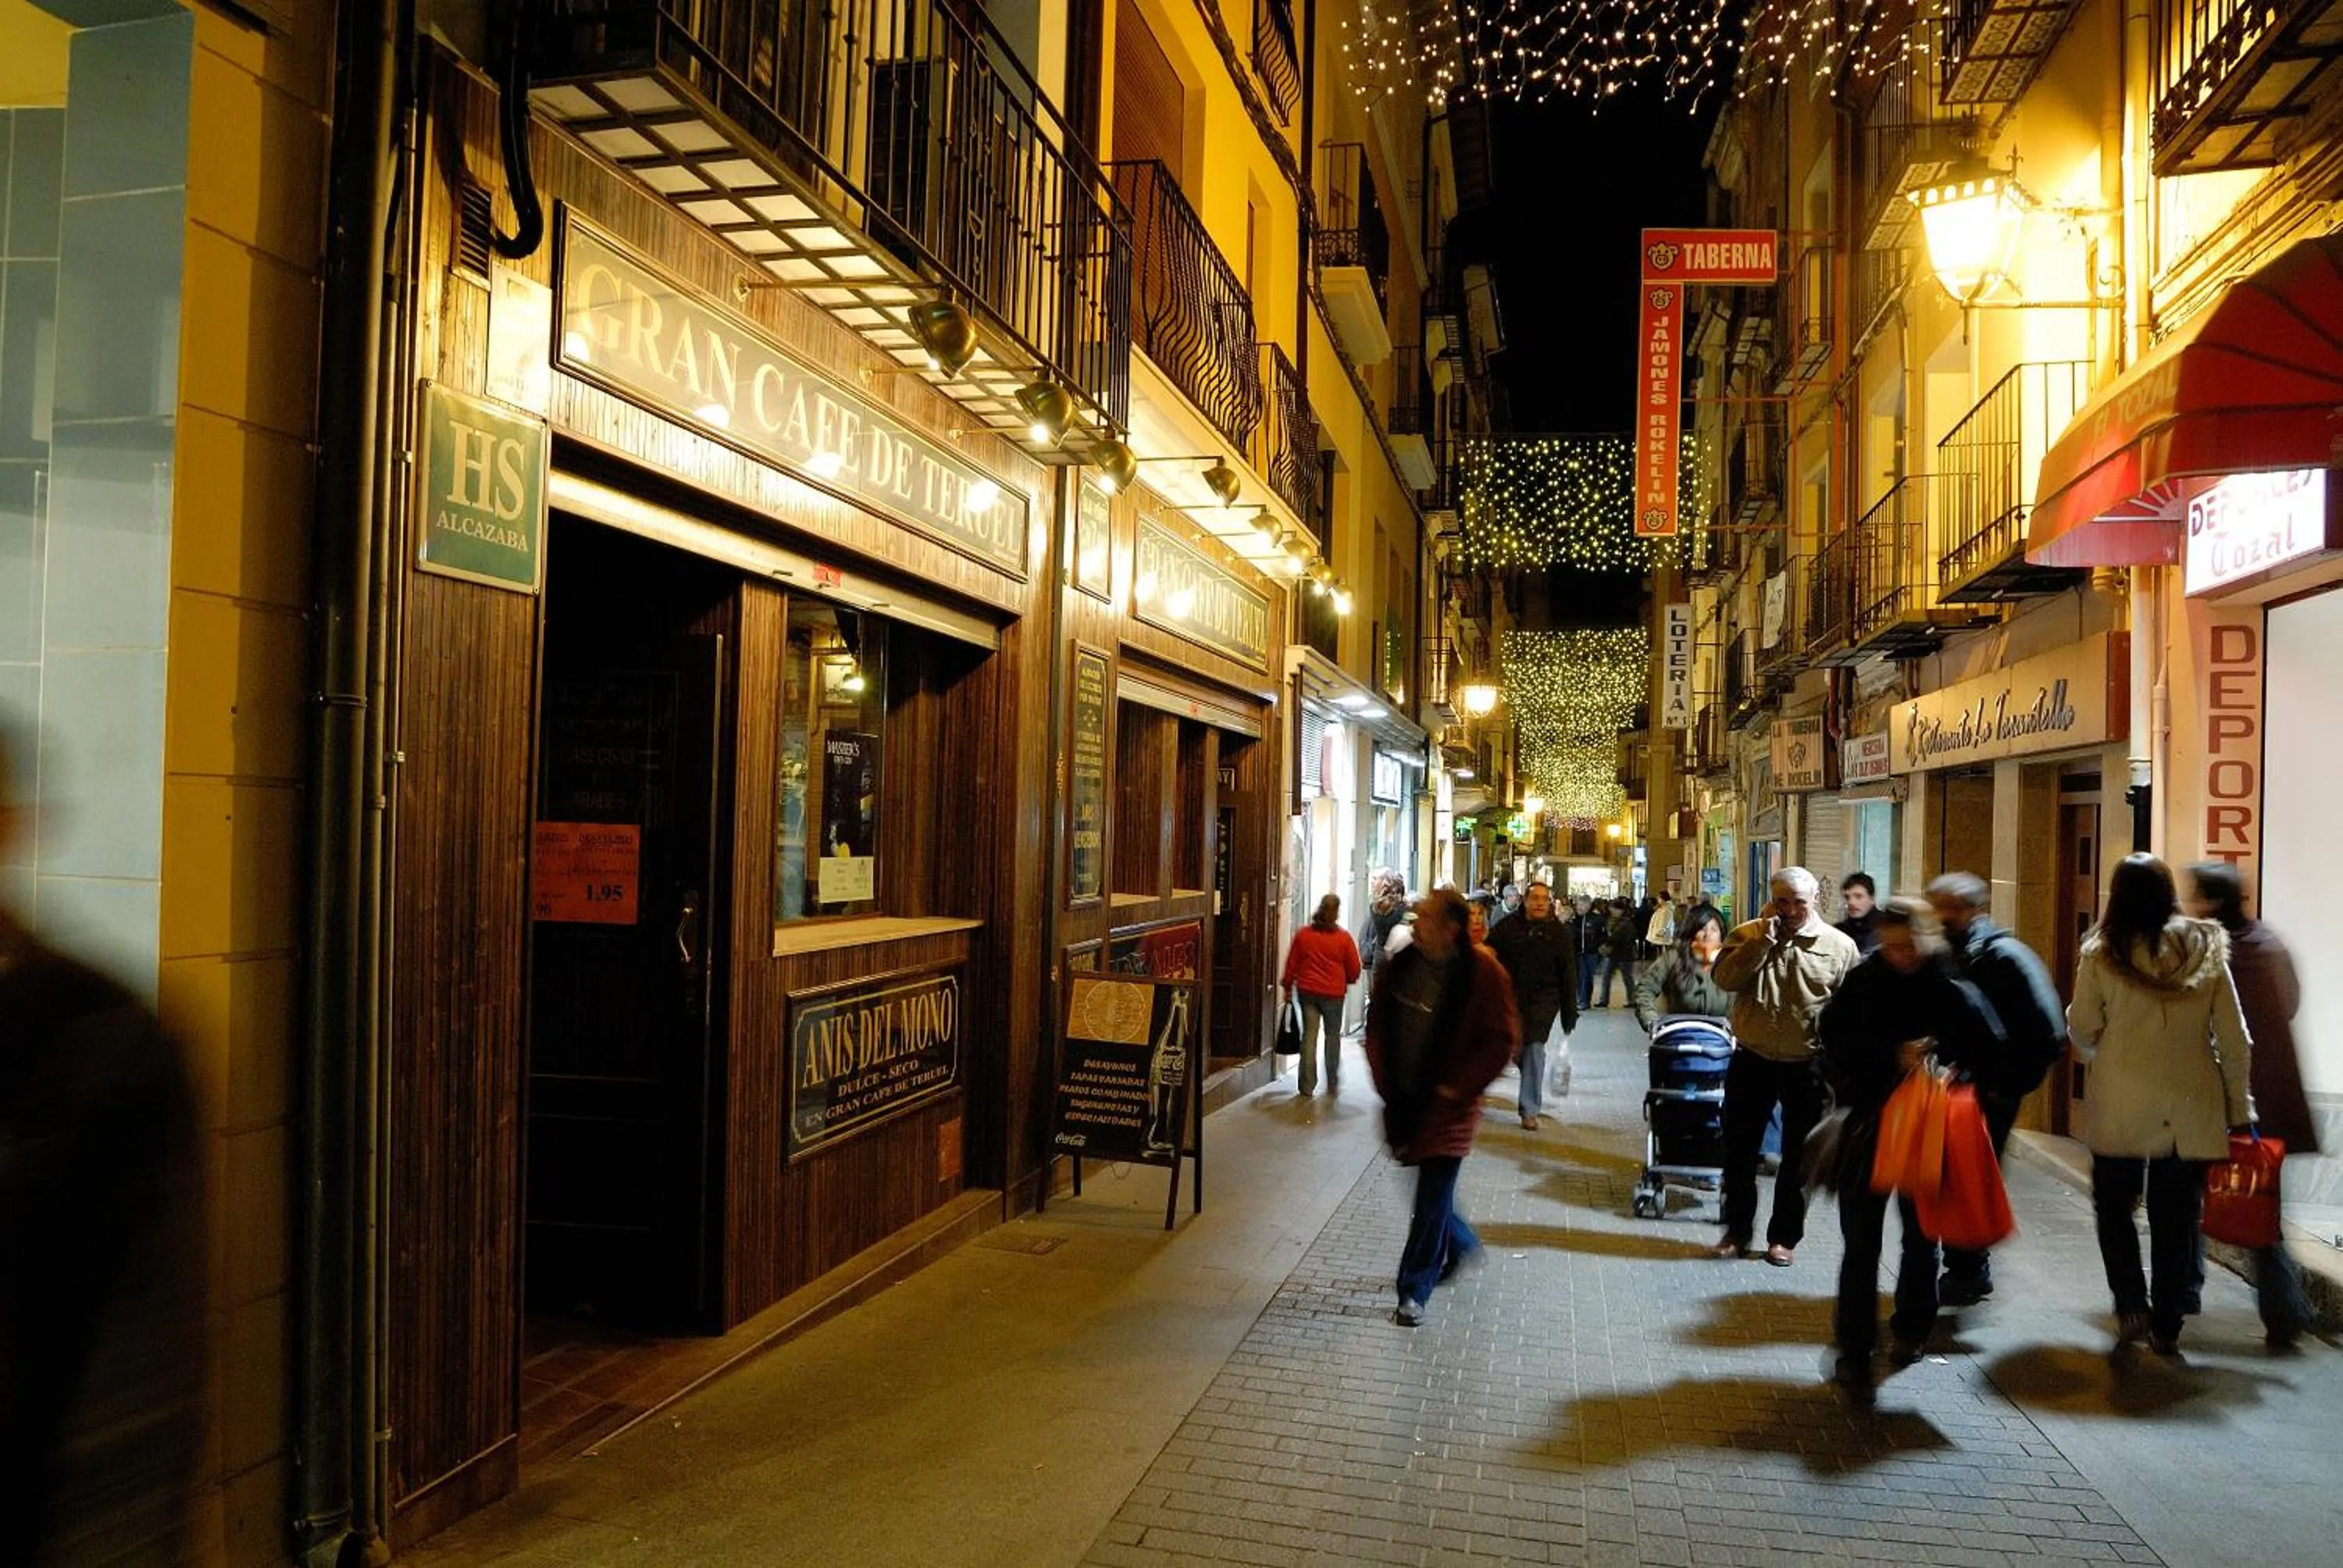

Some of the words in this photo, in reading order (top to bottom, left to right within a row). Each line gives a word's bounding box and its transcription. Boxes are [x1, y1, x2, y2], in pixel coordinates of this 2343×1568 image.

[1683, 243, 1773, 269] TABERNA
[1650, 315, 1671, 405] JAMONES
[576, 263, 742, 414] GRAN
[754, 362, 862, 474] CAFE
[870, 423, 914, 501] DE
[919, 454, 1022, 555] TERUEL
[446, 419, 526, 521] HS
[1648, 414, 1669, 504] ROKELIN
[436, 510, 529, 552] ALCAZABA
[1670, 609, 1688, 711] LOTERIA
[2206, 624, 2256, 900] DEPORT
[802, 1013, 854, 1089] ANIS
[858, 1002, 897, 1069] DEL
[899, 988, 953, 1057] MONO
[837, 1071, 880, 1097] DULCE
[889, 1059, 918, 1079] SECO
[805, 1114, 824, 1128] EN
[825, 1099, 860, 1120] GRAN
[863, 1085, 893, 1106] CAFE
[894, 1078, 909, 1092] DE
[911, 1064, 950, 1087] TERUEL
